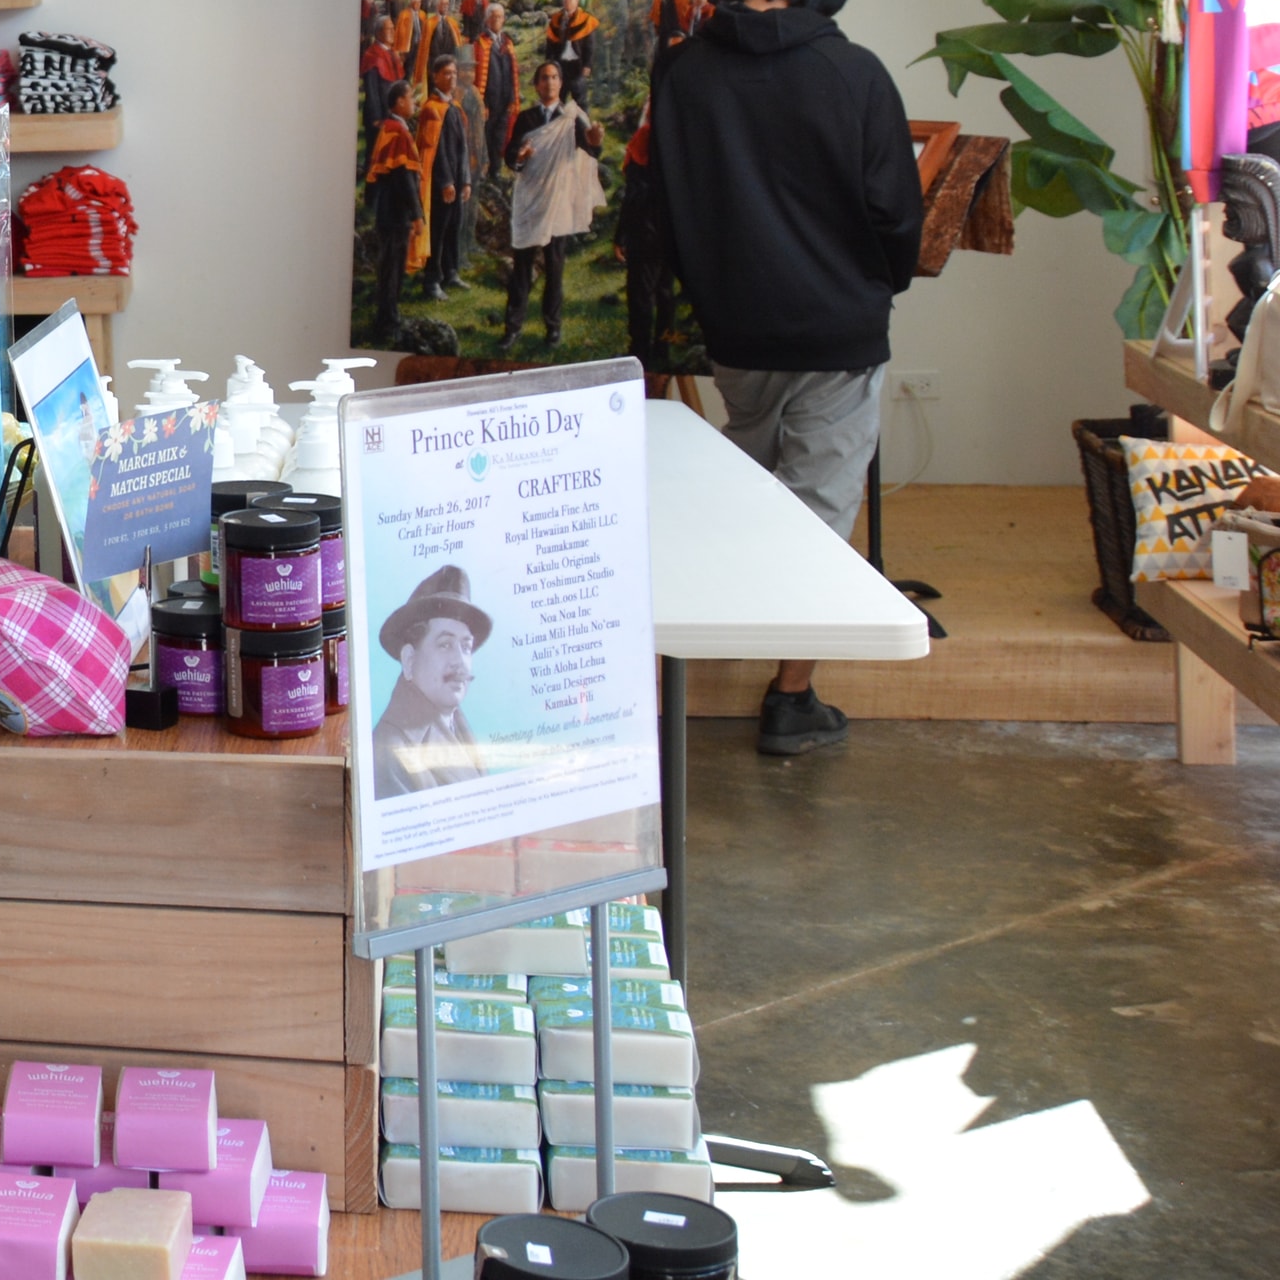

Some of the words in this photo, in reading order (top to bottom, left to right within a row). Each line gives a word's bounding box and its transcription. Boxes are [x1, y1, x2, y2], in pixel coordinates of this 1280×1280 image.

[410, 427, 475, 455] Prince
[479, 414, 540, 444] Kūhiō
[546, 408, 584, 438] Day
[117, 451, 156, 474] MARCH
[157, 446, 179, 464] MIX
[110, 475, 148, 497] MATCH
[148, 464, 192, 488] SPECIAL
[517, 469, 602, 499] CRAFTERS
[377, 506, 412, 525] Sunday
[415, 503, 444, 520] March
[446, 500, 463, 514] 26,
[465, 495, 491, 511] 2017
[522, 508, 559, 523] Kamuela
[561, 504, 580, 517] Fine
[582, 501, 600, 513] Arts
[398, 525, 423, 541] Craft
[425, 522, 444, 537] Fair
[446, 519, 475, 534] Hours
[505, 530, 529, 545] Royal
[531, 524, 570, 540] Hawaiian
[598, 513, 618, 527] LLC
[412, 539, 464, 559] 12pm-5pm
[526, 560, 559, 576] Kaikulu
[561, 552, 601, 570] Originals
[264, 578, 303, 593] wehiwa
[513, 581, 538, 595] Dawn
[539, 573, 585, 591] Yoshimura
[587, 567, 615, 582] Studio
[579, 585, 599, 600] LLC
[540, 612, 557, 625] Noa
[559, 609, 577, 622] Noa
[578, 606, 592, 617] Inc
[525, 631, 547, 646] Lima
[549, 627, 566, 640] Mili
[568, 623, 589, 637] Hulu
[561, 639, 603, 656] Treasures
[173, 668, 212, 682] wehiwa
[530, 665, 551, 678] With
[553, 659, 578, 674] Aloha
[579, 655, 606, 670] Lehua
[563, 672, 606, 690] Designers
[287, 684, 319, 700] wehiwa
[544, 695, 578, 712] Kamaka
[579, 691, 594, 705] Pili
[536, 722, 561, 736] those
[27, 1071, 85, 1084] wehiwa
[138, 1078, 197, 1089] wehiwa
